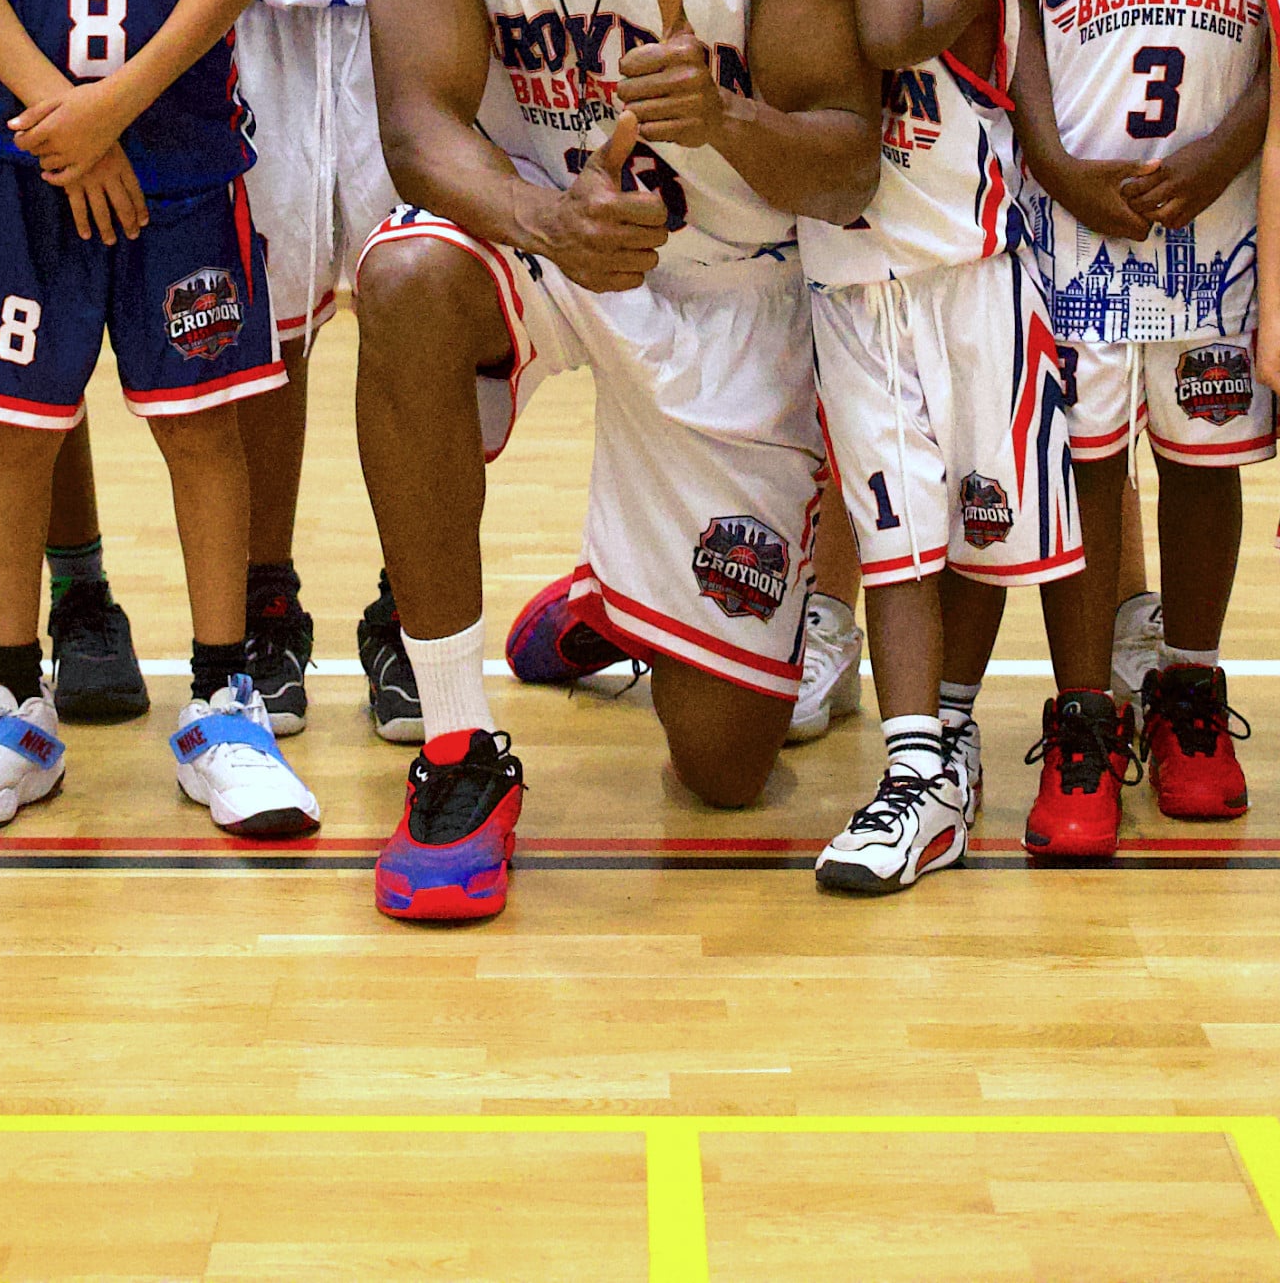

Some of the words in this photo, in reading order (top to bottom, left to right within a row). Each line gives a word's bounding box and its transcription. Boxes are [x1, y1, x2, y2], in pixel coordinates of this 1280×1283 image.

[1080, 7, 1187, 46] DEVELOPMENT
[1191, 10, 1244, 43] LEAGUE
[1126, 46, 1186, 140] 3
[170, 303, 241, 338] CROYDON
[1180, 378, 1251, 401] CROYDON
[867, 471, 901, 531] 1
[696, 549, 784, 602] CROYDON
[20, 729, 56, 762] NIKE
[176, 725, 208, 756] NIKE
